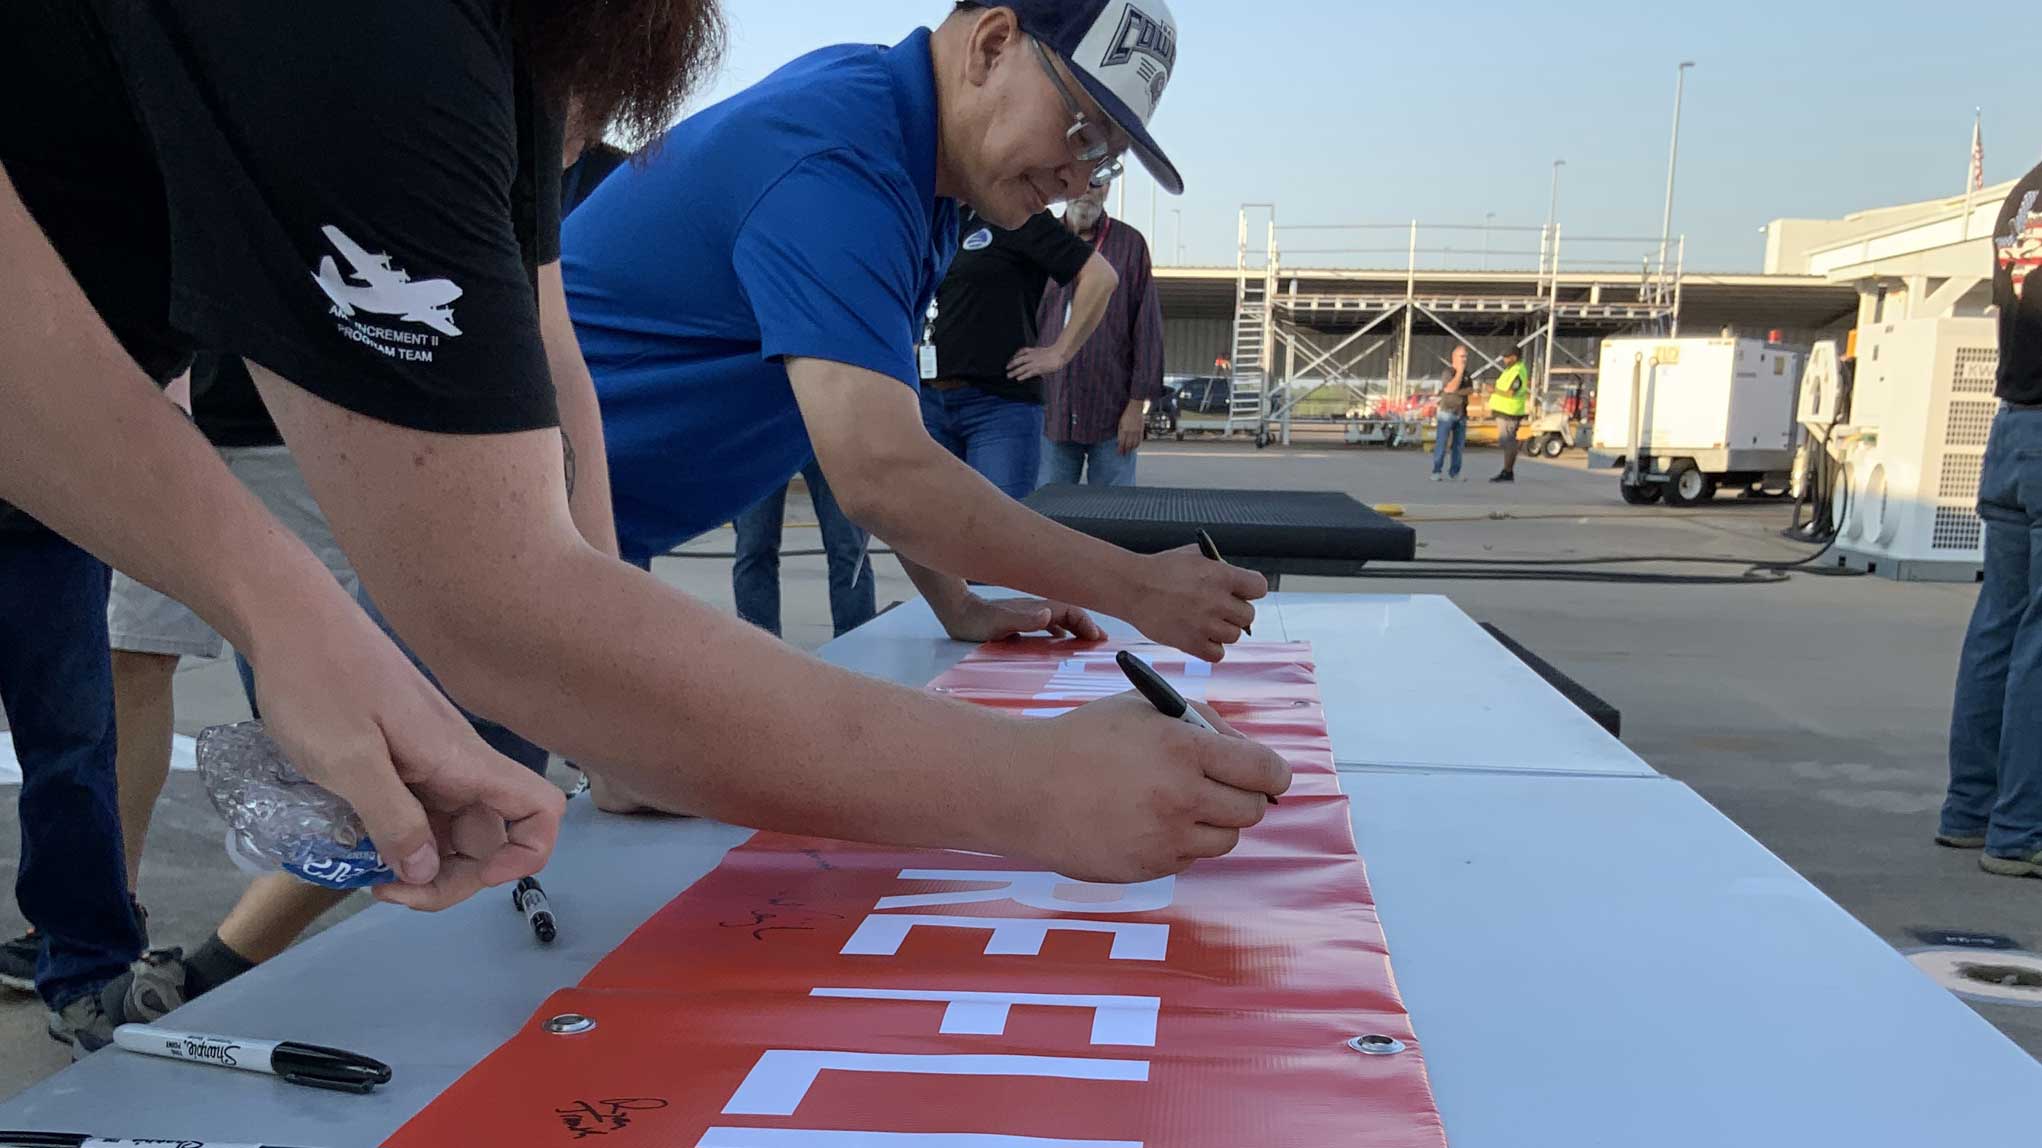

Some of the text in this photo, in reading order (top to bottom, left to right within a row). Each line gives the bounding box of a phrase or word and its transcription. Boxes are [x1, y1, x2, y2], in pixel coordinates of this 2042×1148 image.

[337, 323, 433, 362] PROGRAM TEAM
[354, 322, 428, 346] INCREMENT
